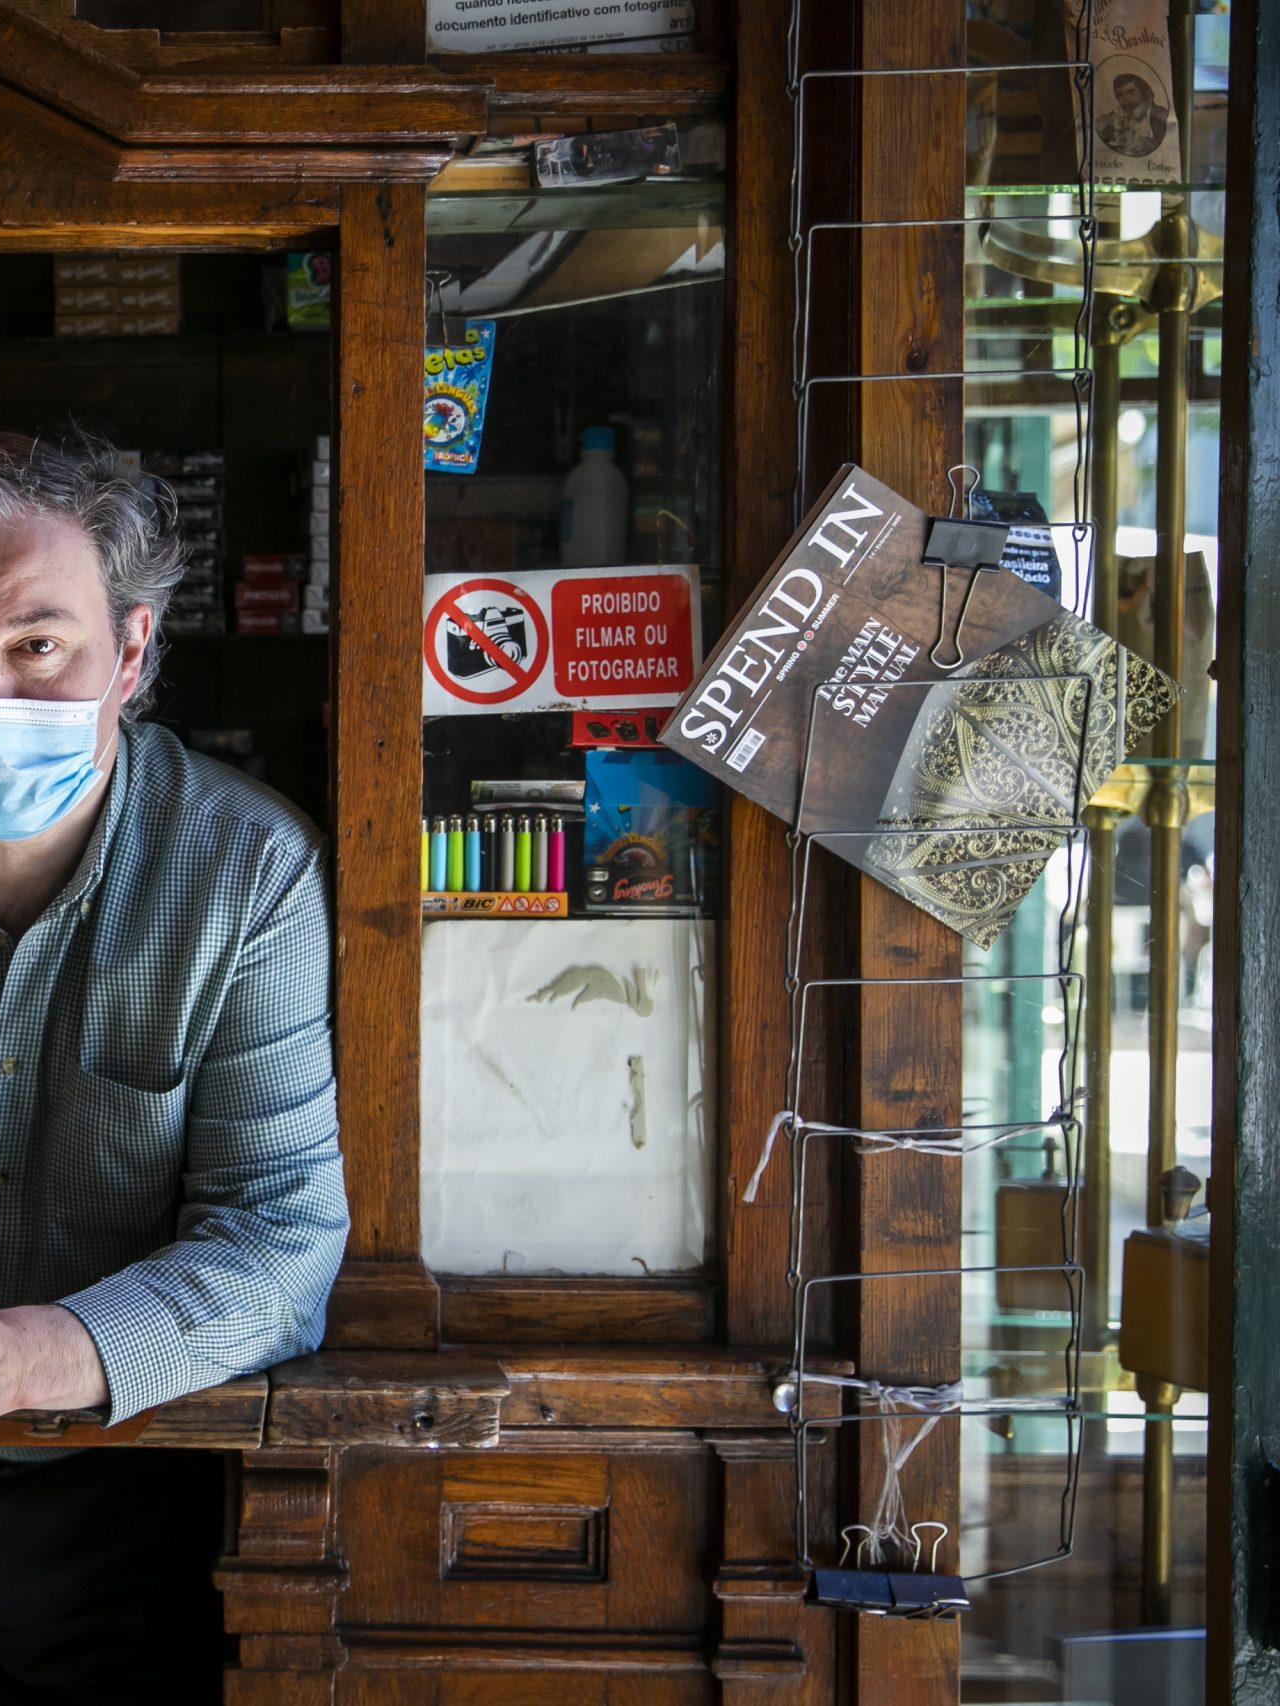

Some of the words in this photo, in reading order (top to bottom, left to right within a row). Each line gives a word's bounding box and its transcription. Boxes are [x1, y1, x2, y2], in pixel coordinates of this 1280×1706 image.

[434, 16, 507, 31] documento
[510, 7, 590, 25] identificativo
[593, 4, 621, 15] com
[624, 0, 684, 13] fotografi
[581, 590, 660, 615] PROIBIDO
[680, 568, 823, 755] SPEND
[807, 481, 885, 569] IN
[575, 625, 636, 648] FILMAR
[644, 624, 667, 646] OU
[775, 651, 800, 682] SPRING
[811, 593, 840, 630] SUMMER
[839, 616, 882, 669] MAIN
[567, 657, 679, 682] FOTOGRAFAR
[832, 626, 903, 717] STYLE
[852, 643, 920, 728] MANUAL
[463, 898, 494, 909] BIC
